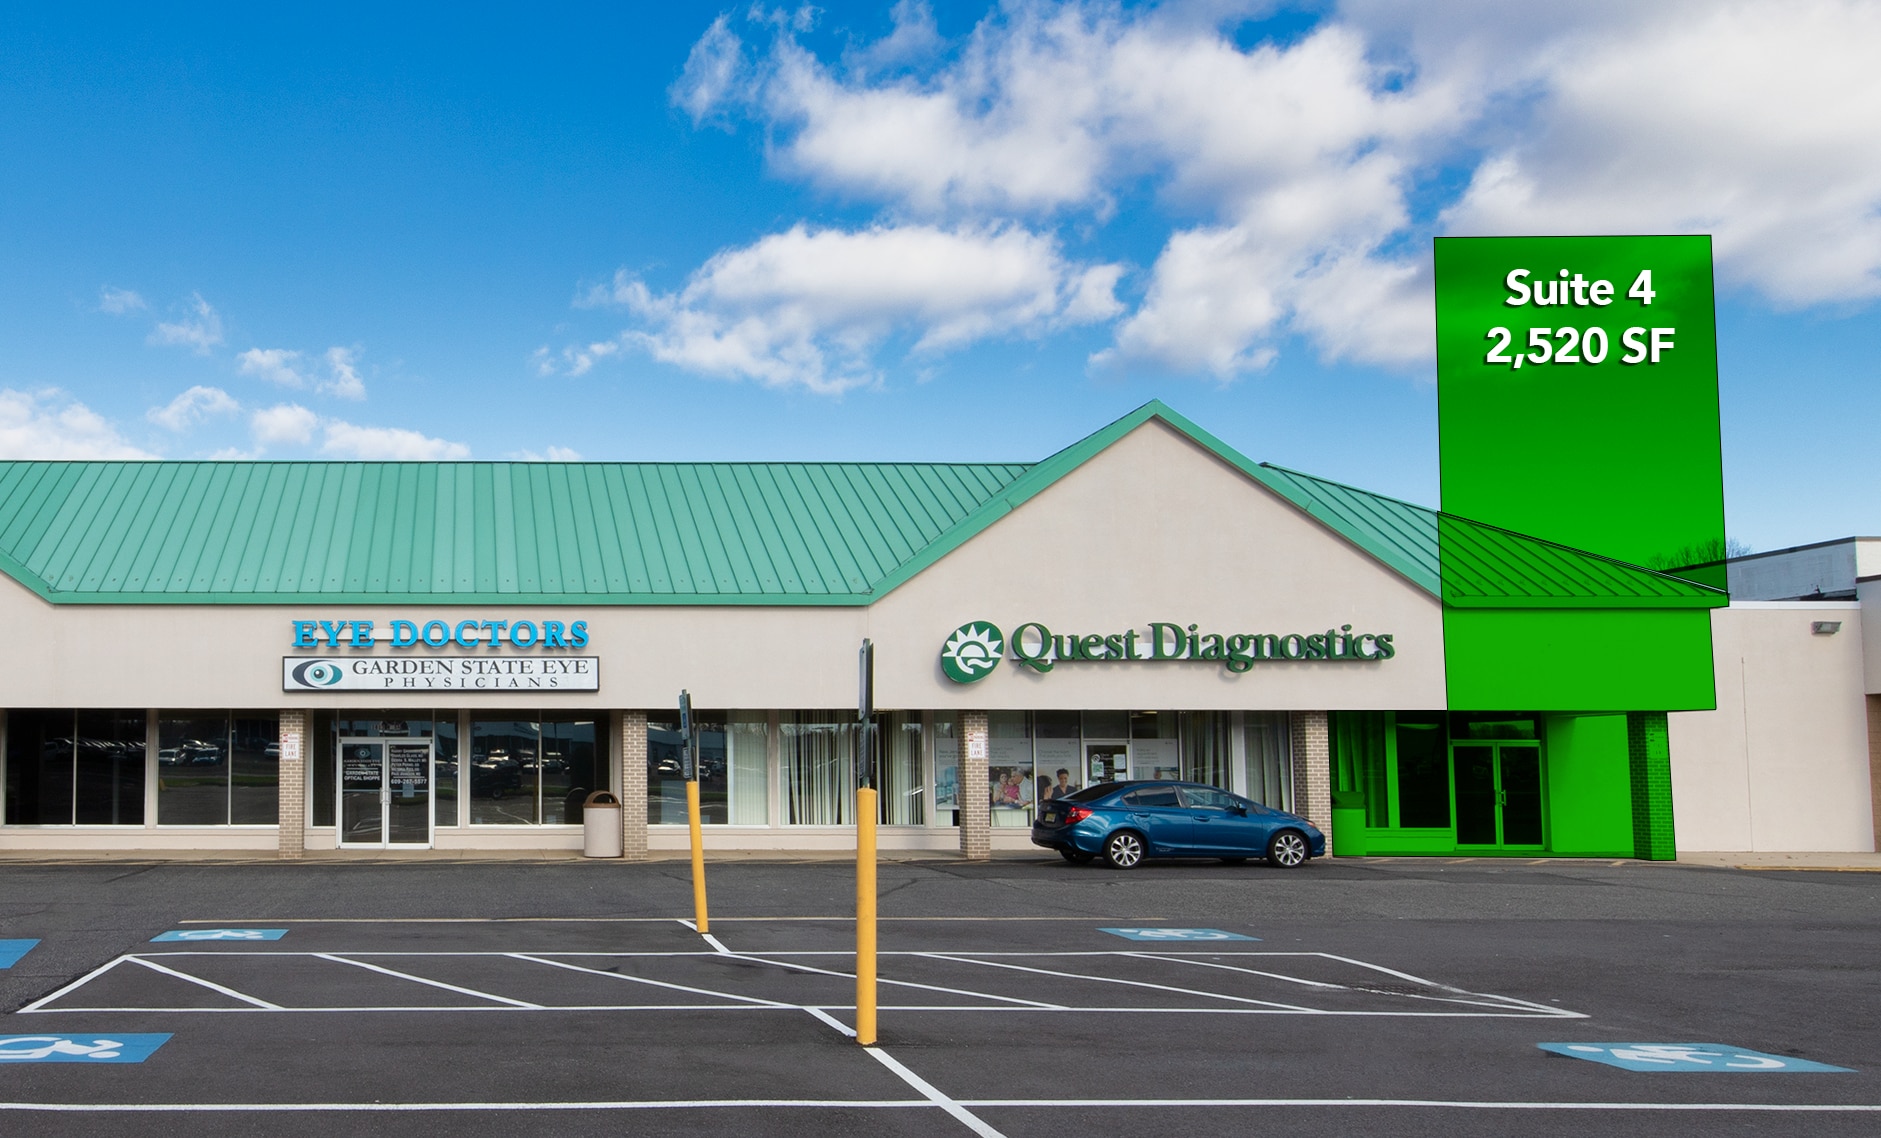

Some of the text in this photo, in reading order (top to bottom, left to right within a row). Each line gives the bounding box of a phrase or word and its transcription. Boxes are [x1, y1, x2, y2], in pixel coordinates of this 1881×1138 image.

[291, 619, 590, 648] EYE DOCTORS
[1010, 621, 1396, 673] Quest Diagnostics
[352, 659, 590, 675] GARDEN STATE EYE
[384, 676, 560, 688] PHYSICIANS
